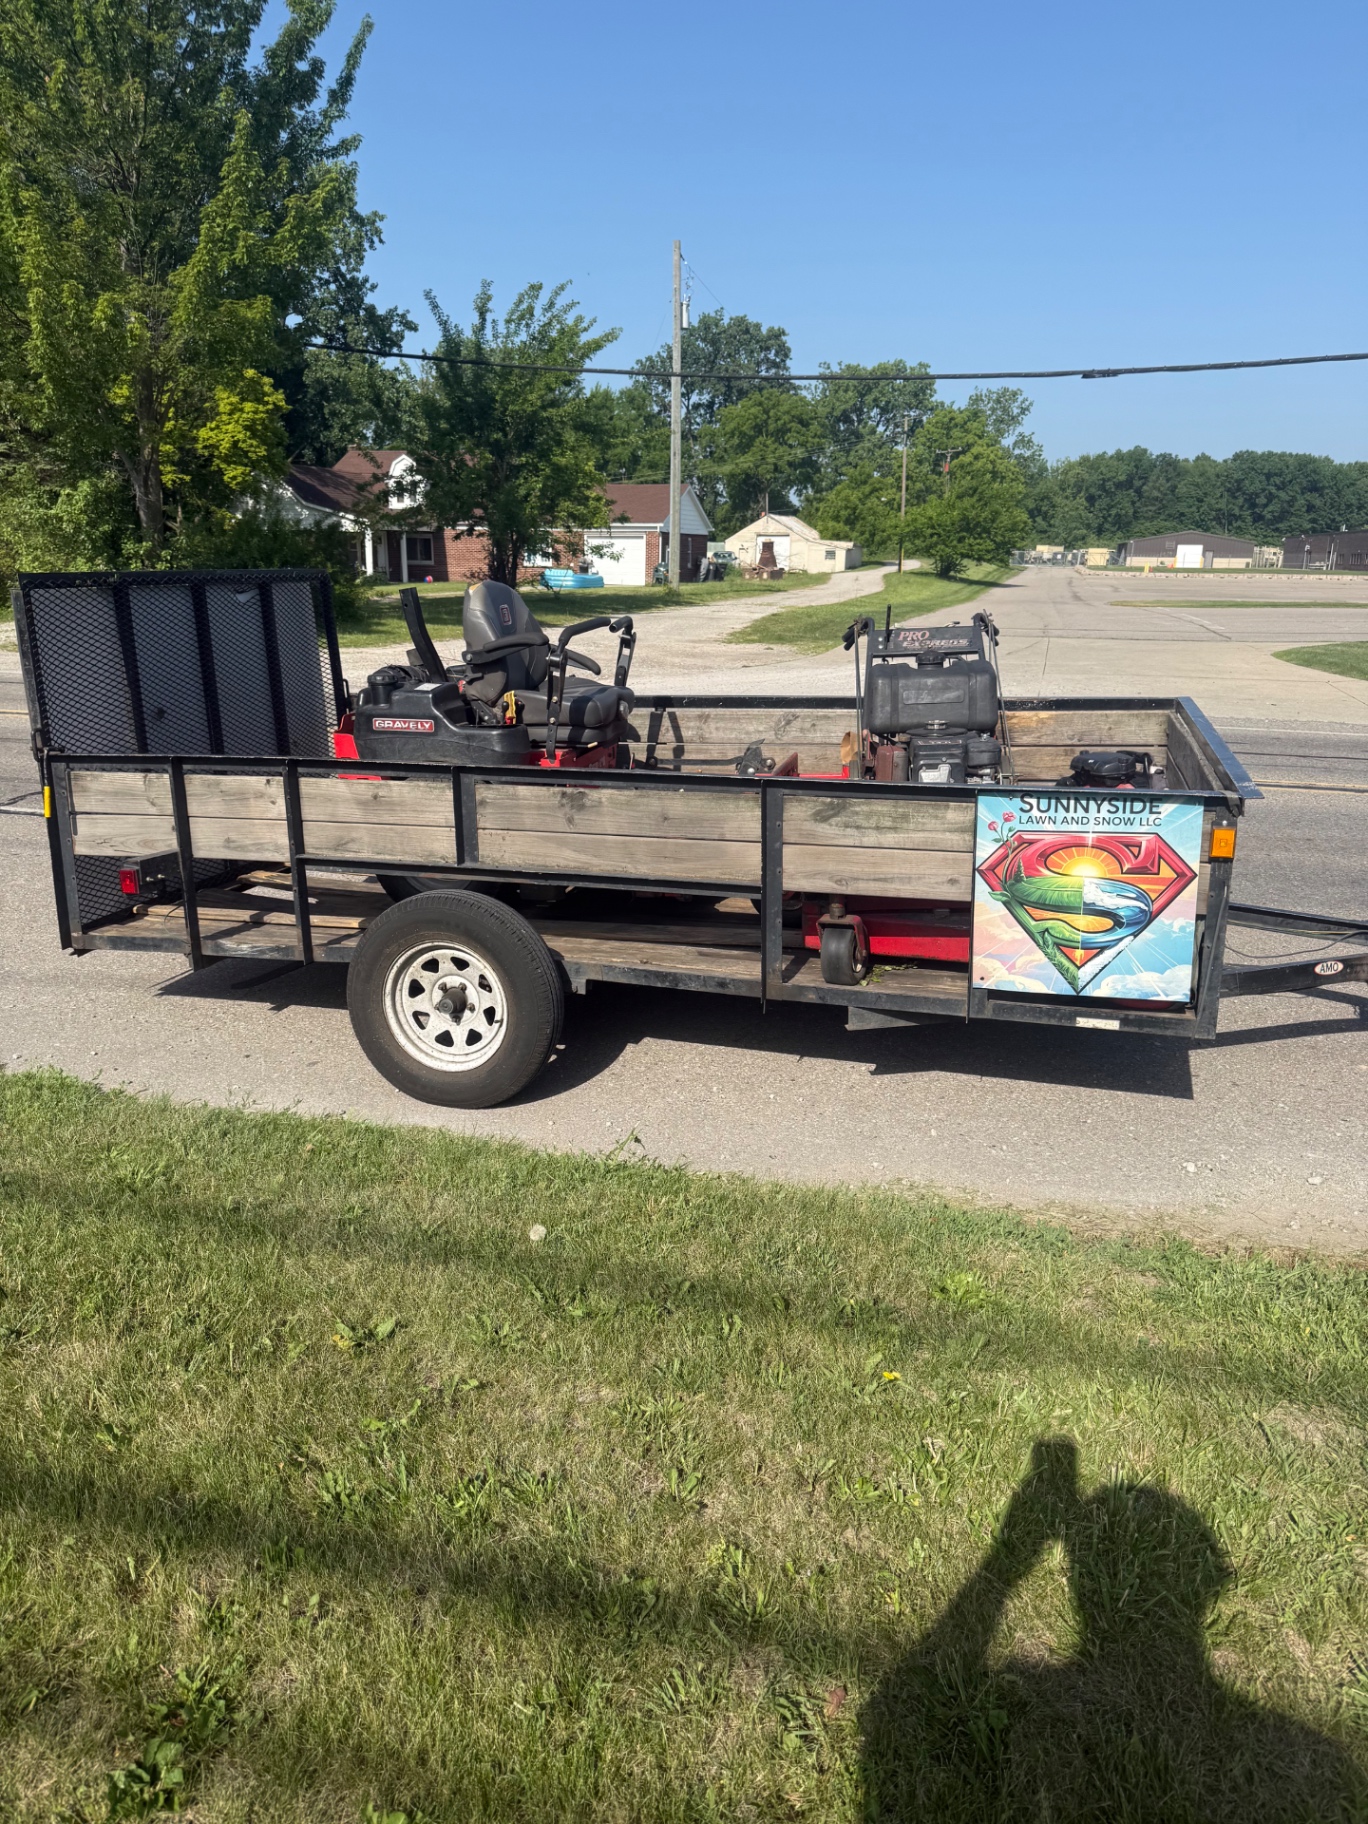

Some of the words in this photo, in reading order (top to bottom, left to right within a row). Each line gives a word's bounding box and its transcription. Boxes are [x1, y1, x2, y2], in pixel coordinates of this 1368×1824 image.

[898, 630, 930, 641] PRO
[375, 720, 432, 730] GRAVELY
[1019, 792, 1163, 815] SUNNYSIDE
[1019, 815, 1057, 825] LAWN
[1060, 816, 1090, 826] AND
[1093, 816, 1136, 827] SNOW
[1139, 817, 1162, 827] LLC
[1319, 962, 1339, 974] AMO
